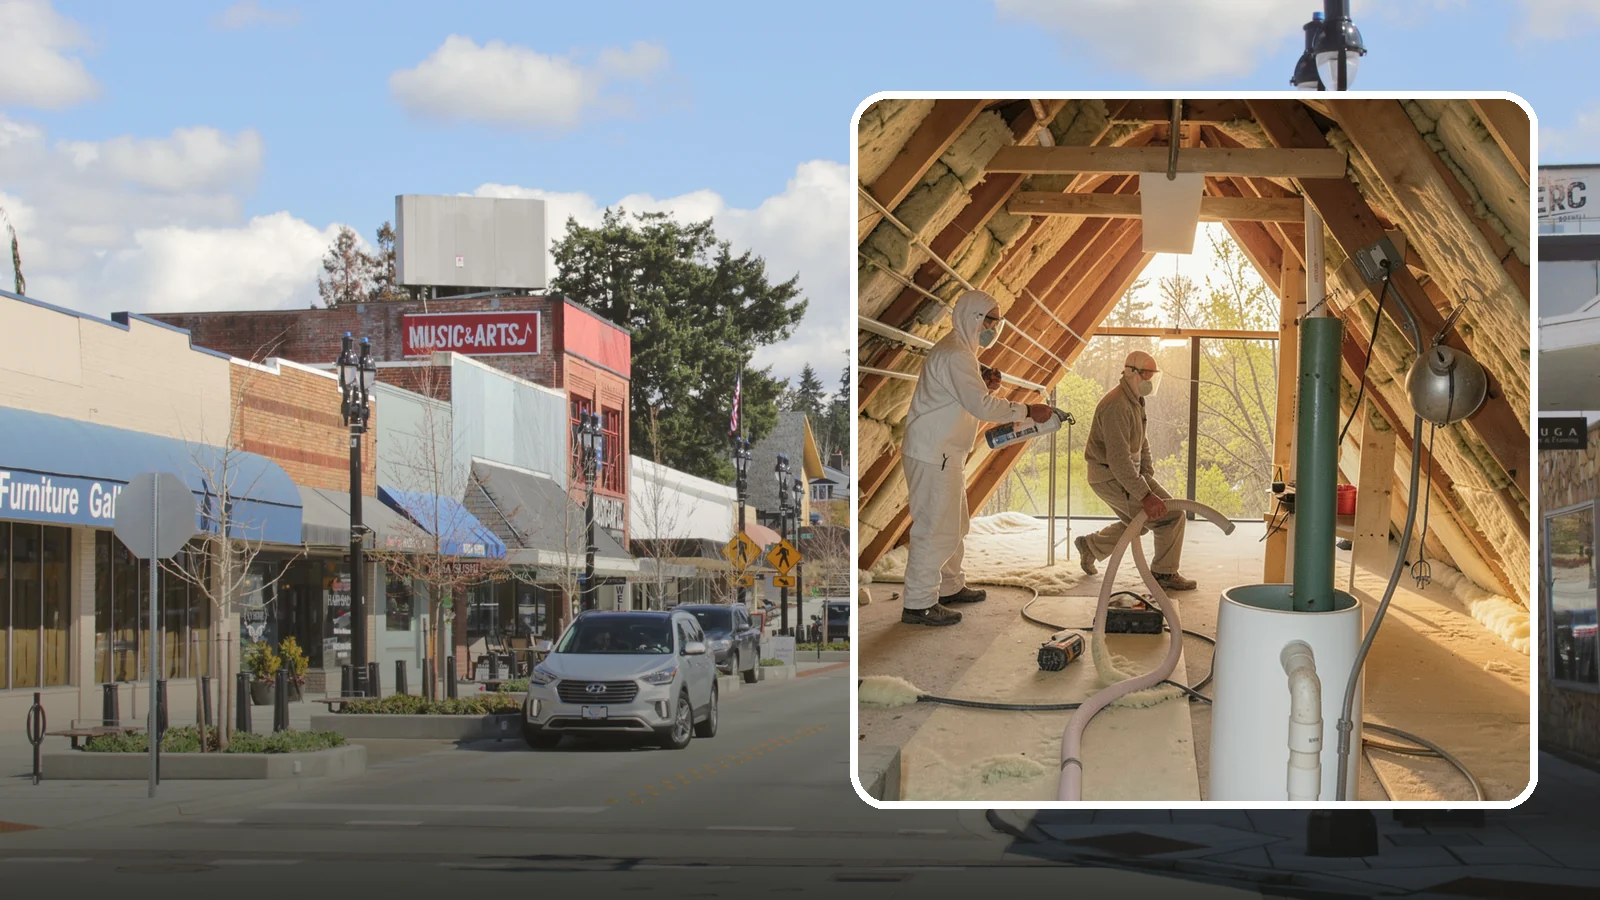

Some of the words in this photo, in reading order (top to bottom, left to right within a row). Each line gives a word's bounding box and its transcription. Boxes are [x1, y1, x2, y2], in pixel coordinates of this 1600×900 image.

[409, 323, 519, 348] MUSIC&ARTS
[1540, 428, 1577, 436] UGA
[0, 472, 79, 515] Furniture
[453, 563, 479, 574] SUSHI
